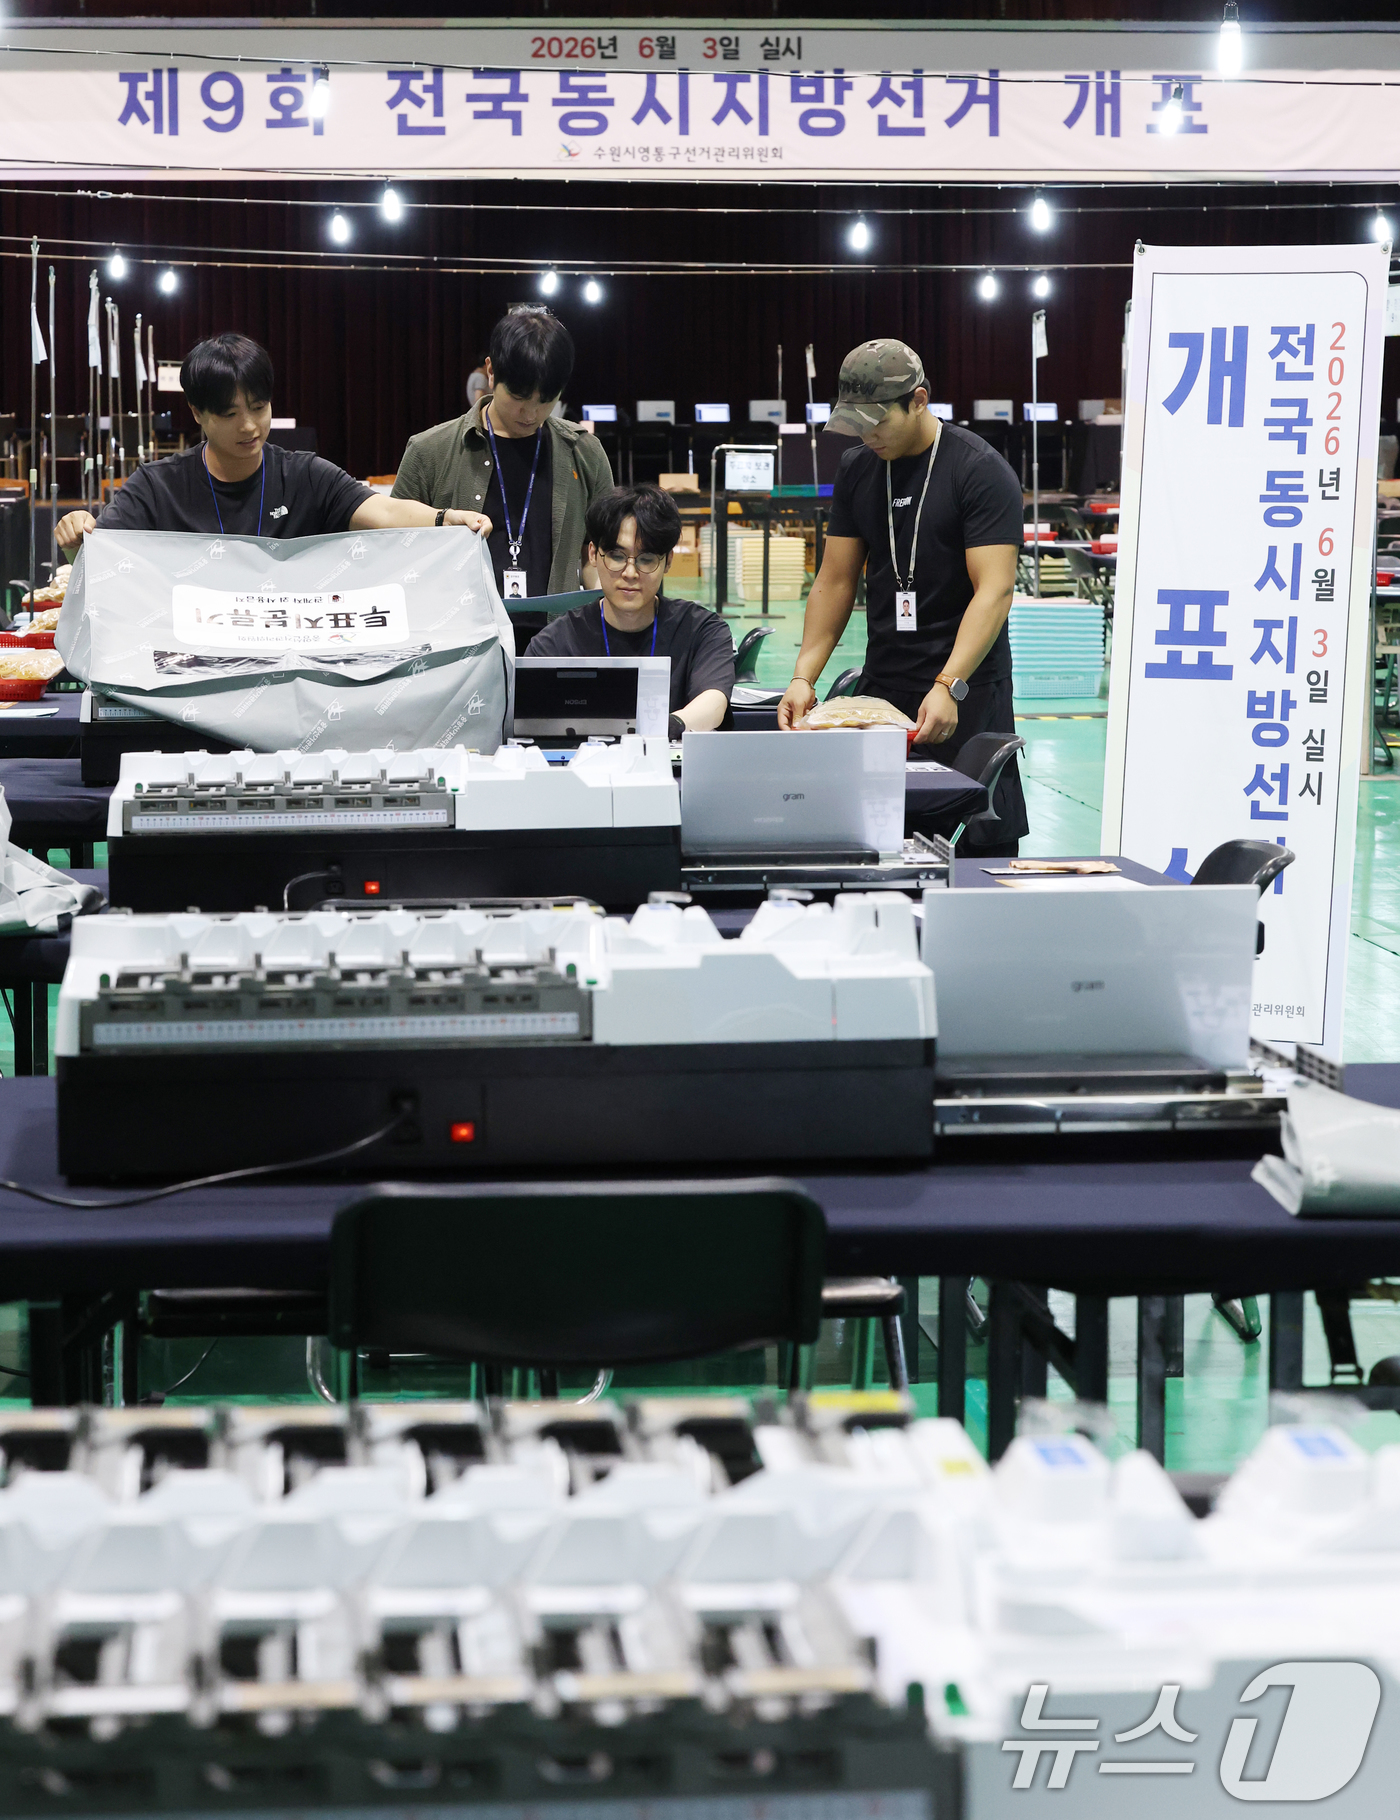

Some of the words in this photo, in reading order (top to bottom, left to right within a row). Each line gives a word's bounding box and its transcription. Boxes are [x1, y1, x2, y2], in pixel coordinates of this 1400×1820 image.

[531, 36, 618, 60] 2026년
[638, 36, 676, 60] 6월
[702, 36, 740, 60] 3일
[760, 36, 802, 60] 실시
[117, 67, 325, 136] 제9회
[385, 67, 1000, 137] 전국동시지방선거
[1062, 69, 1209, 137] 개표
[593, 146, 784, 163] 수원시영통구선거관리위원회
[1317, 321, 1347, 501] 2026년
[1311, 527, 1336, 602] 6월
[195, 605, 391, 629] 투표지분류기
[293, 596, 323, 604] 관계자
[1306, 629, 1329, 703] 3일
[1298, 728, 1326, 806] 실시
[782, 793, 805, 802] gram
